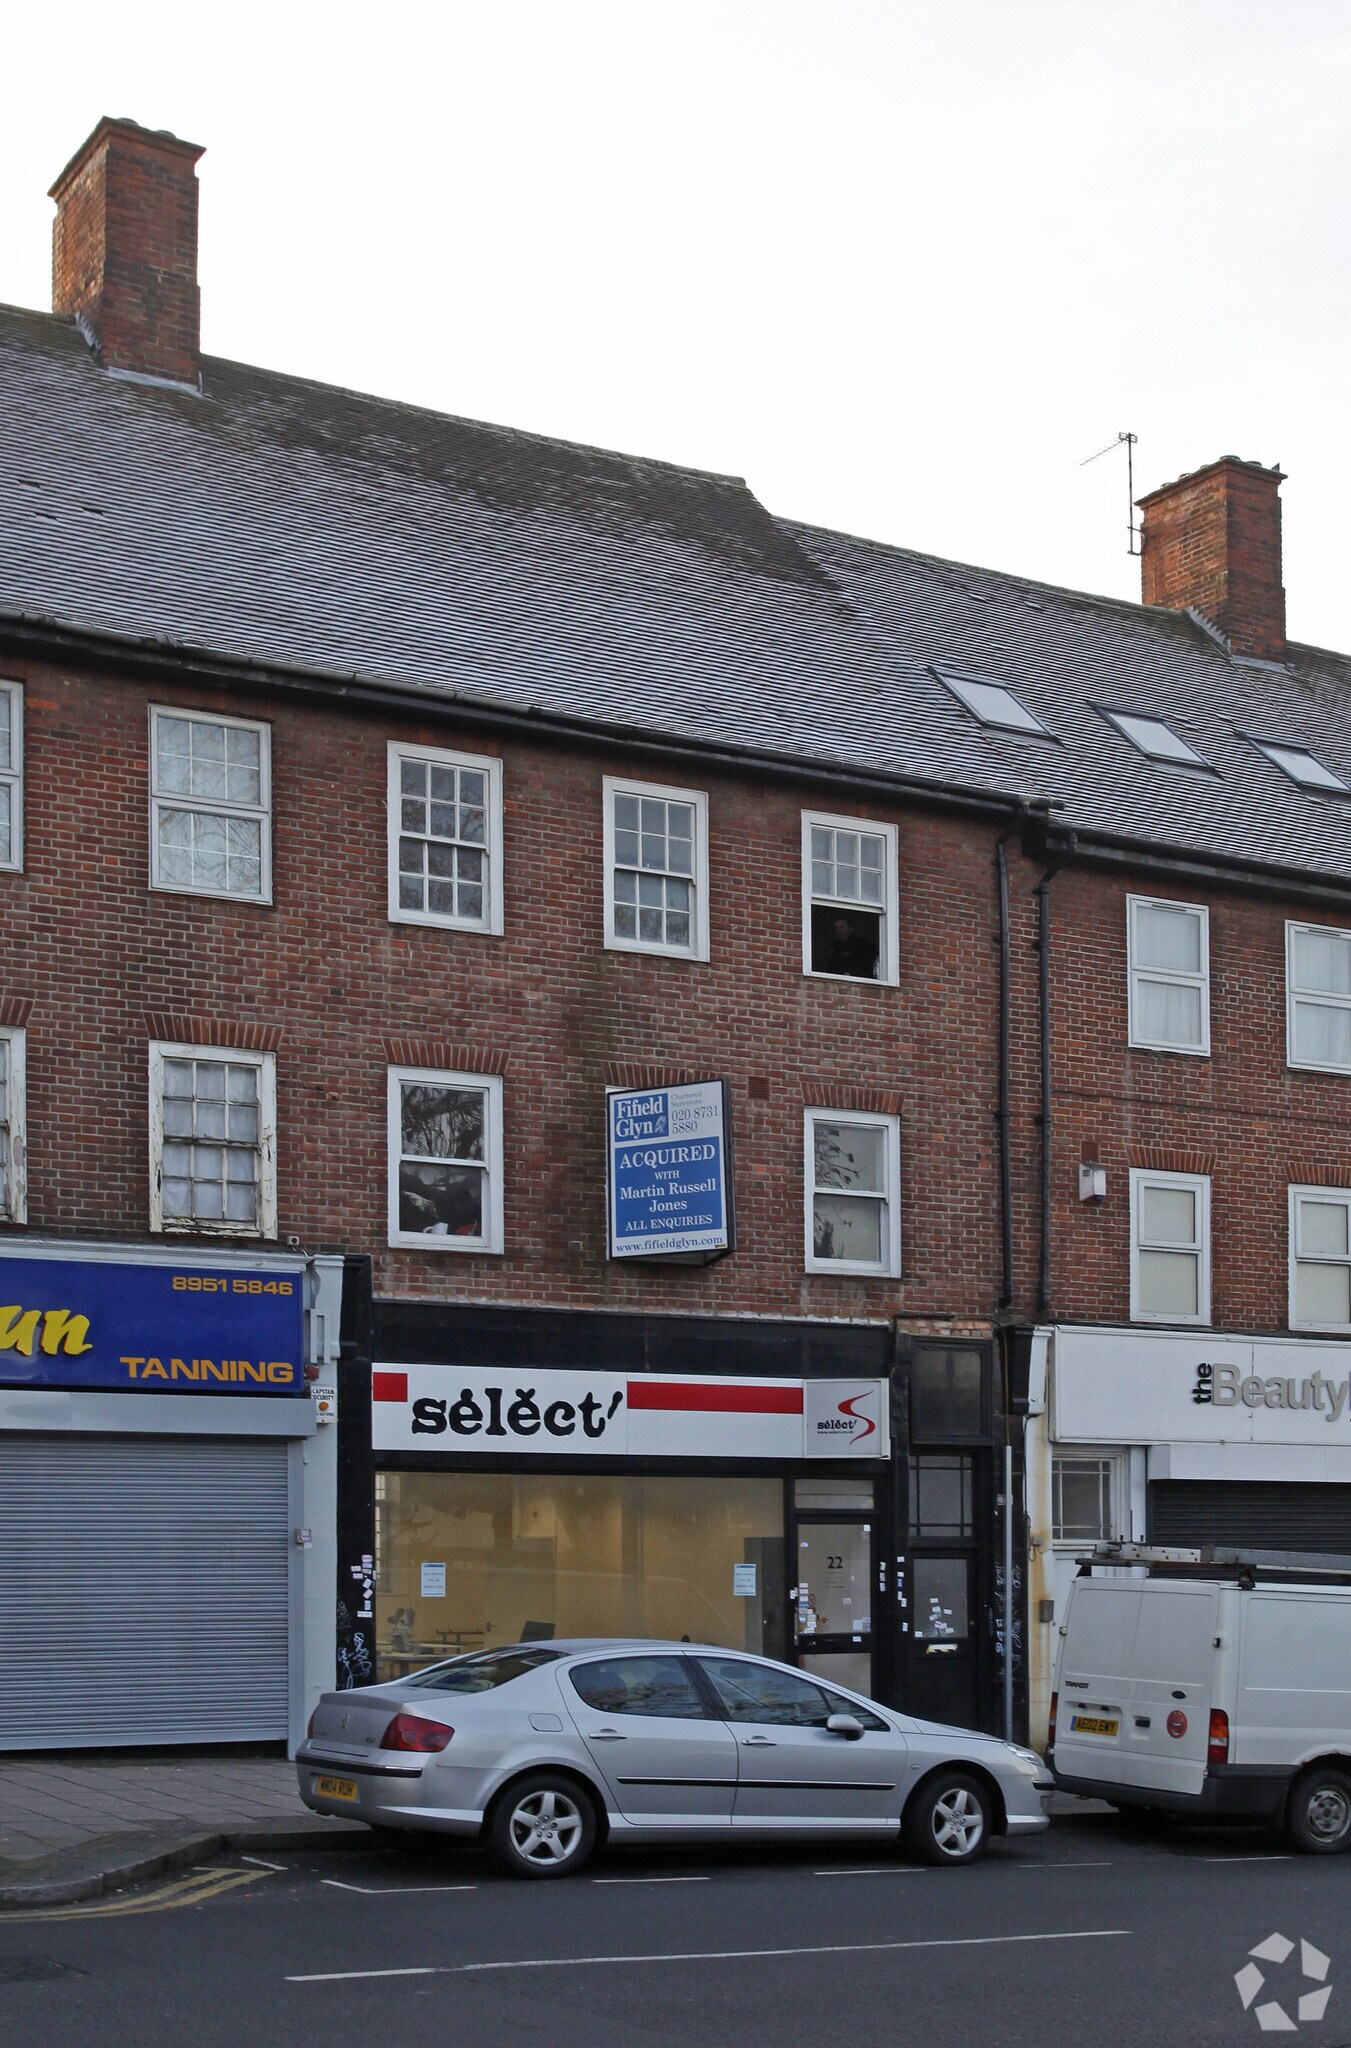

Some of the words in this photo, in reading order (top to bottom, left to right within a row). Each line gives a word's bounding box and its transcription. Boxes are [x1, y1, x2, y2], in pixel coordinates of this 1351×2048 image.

[671, 1091, 702, 1100] Chartered
[616, 1096, 664, 1119] Fifield
[671, 1109, 691, 1122] 020
[693, 1105, 719, 1119] 8731
[615, 1119, 654, 1139] Glyn
[671, 1121, 698, 1134] 5880
[619, 1144, 716, 1169] ACQUIRED
[654, 1170, 680, 1180] WITH
[620, 1184, 665, 1200] Martin
[669, 1179, 717, 1196] Russell
[649, 1199, 688, 1213] Jones
[625, 1220, 647, 1232] ALL
[650, 1214, 713, 1229] ENQUIRIES
[616, 1236, 723, 1252] www.fifieldglyn.com
[172, 1276, 228, 1292] 8951
[232, 1279, 293, 1295] 5846
[120, 1357, 294, 1383] TANNING
[1191, 1361, 1213, 1404] the
[827, 1556, 843, 1569] 22
[1065, 1680, 1089, 1689] TRANSIT
